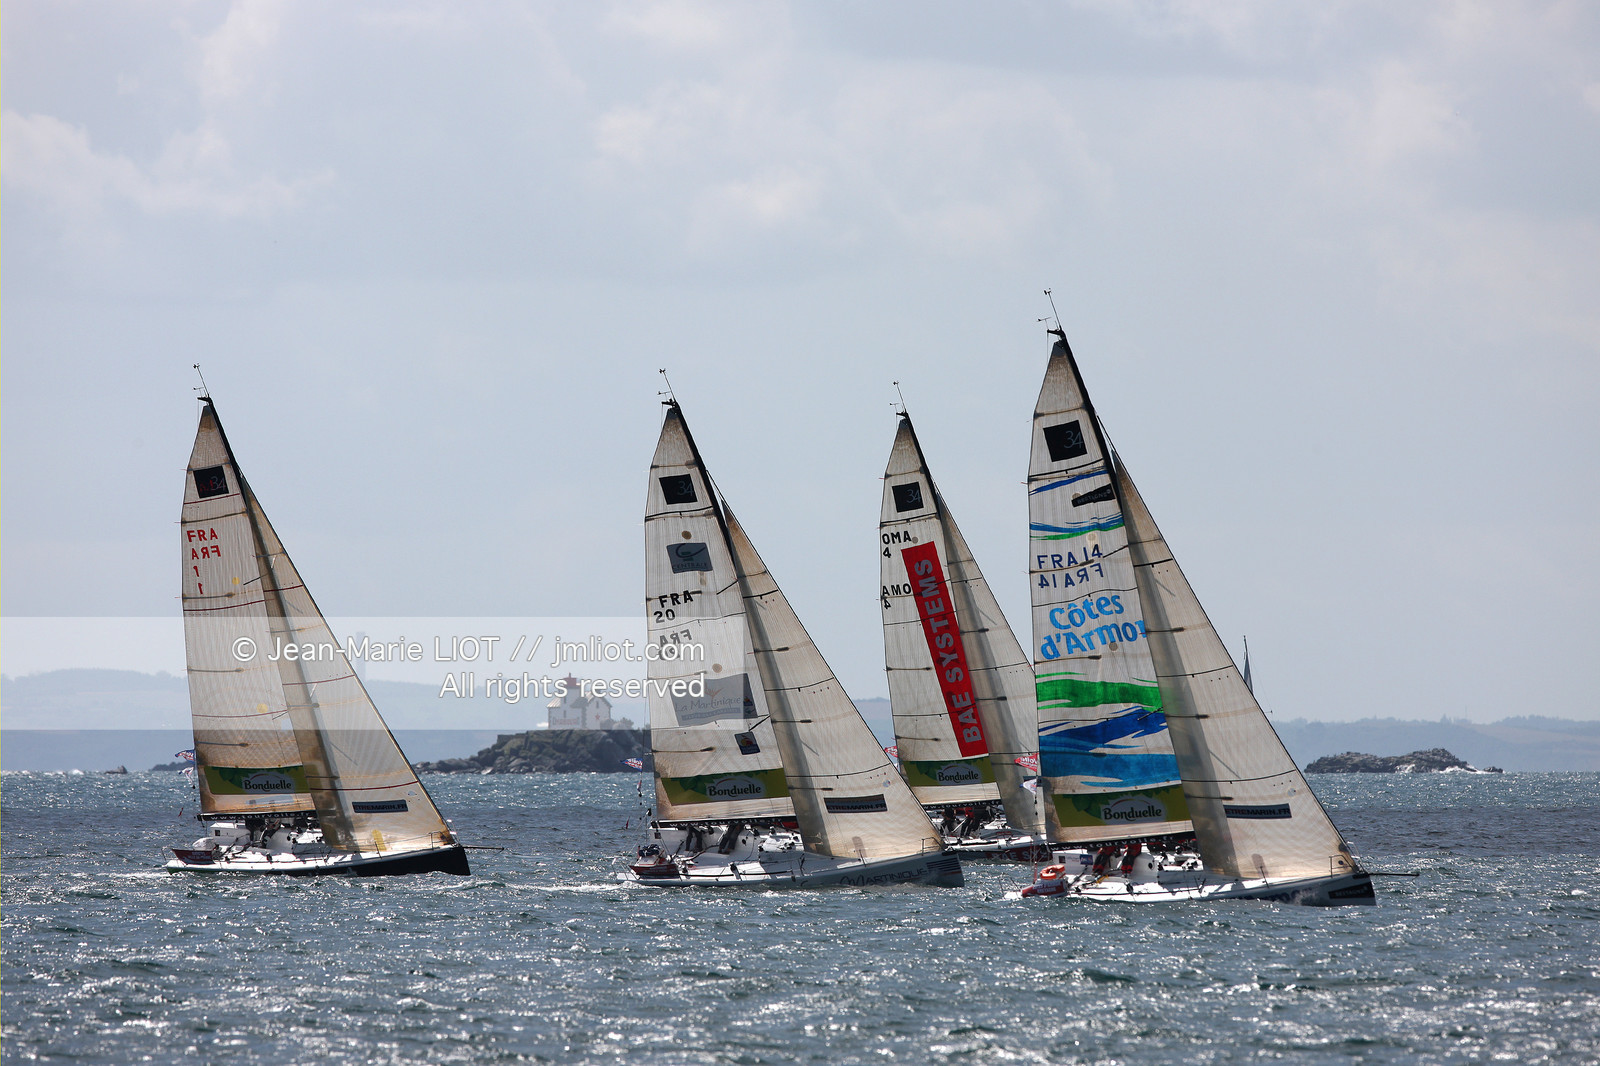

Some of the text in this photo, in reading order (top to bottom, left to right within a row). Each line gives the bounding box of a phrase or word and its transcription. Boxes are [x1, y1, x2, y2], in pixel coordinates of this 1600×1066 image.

[187, 528, 219, 543] FRA
[882, 530, 912, 545] OMA
[883, 547, 891, 558] 4
[193, 565, 200, 577] 1
[659, 590, 694, 608] FRA
[653, 608, 676, 624] 20
[1049, 594, 1124, 630] Côtes
[914, 559, 982, 743] BAE SYSTEMS
[675, 696, 741, 712] La Martinique
[938, 767, 979, 784] Bonduelle
[243, 778, 292, 793] Bonduelle
[708, 783, 762, 798] Bonduelle
[1103, 804, 1162, 822] Bonduelle
